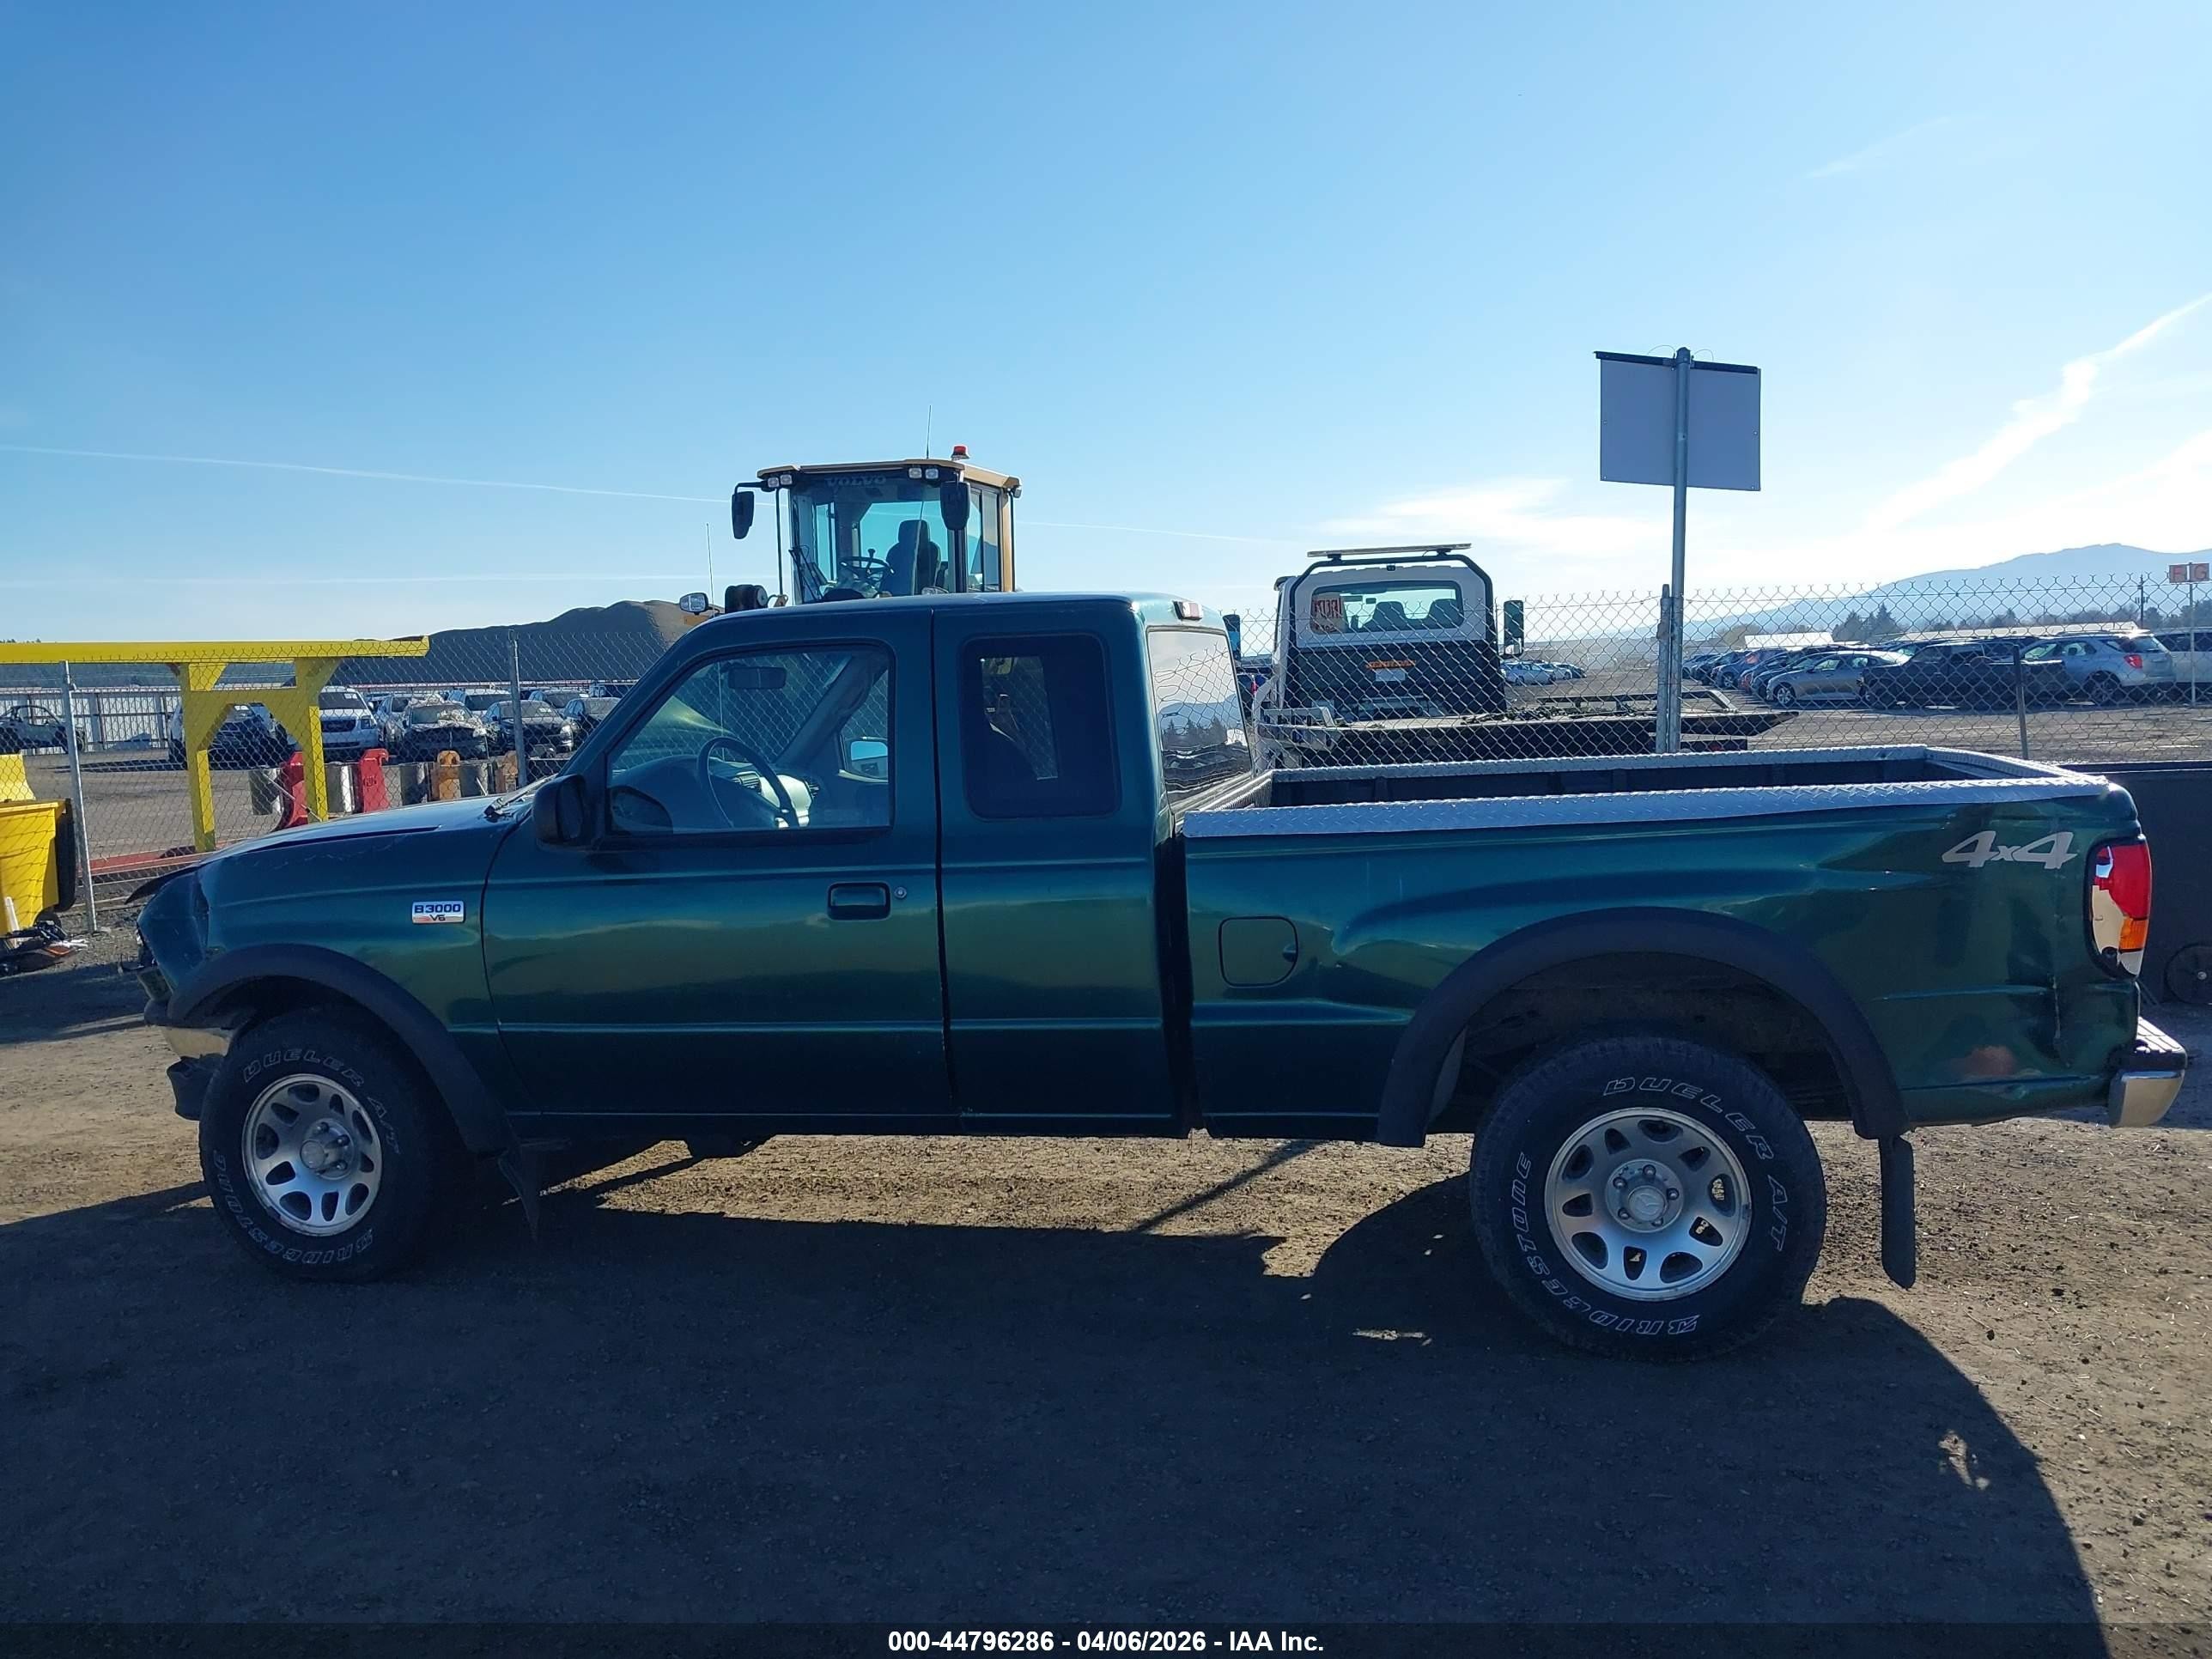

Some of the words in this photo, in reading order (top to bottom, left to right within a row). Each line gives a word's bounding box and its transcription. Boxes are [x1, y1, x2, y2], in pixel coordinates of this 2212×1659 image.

[824, 474, 886, 487] VOLVO
[1942, 830, 2077, 869] 4x4
[415, 904, 461, 913] B3000
[243, 1048, 365, 1088] DUELER
[1602, 1076, 1776, 1161] DUELER
[1766, 1173, 1788, 1252] A/T
[1510, 1152, 1701, 1336] BRIDGESTONE
